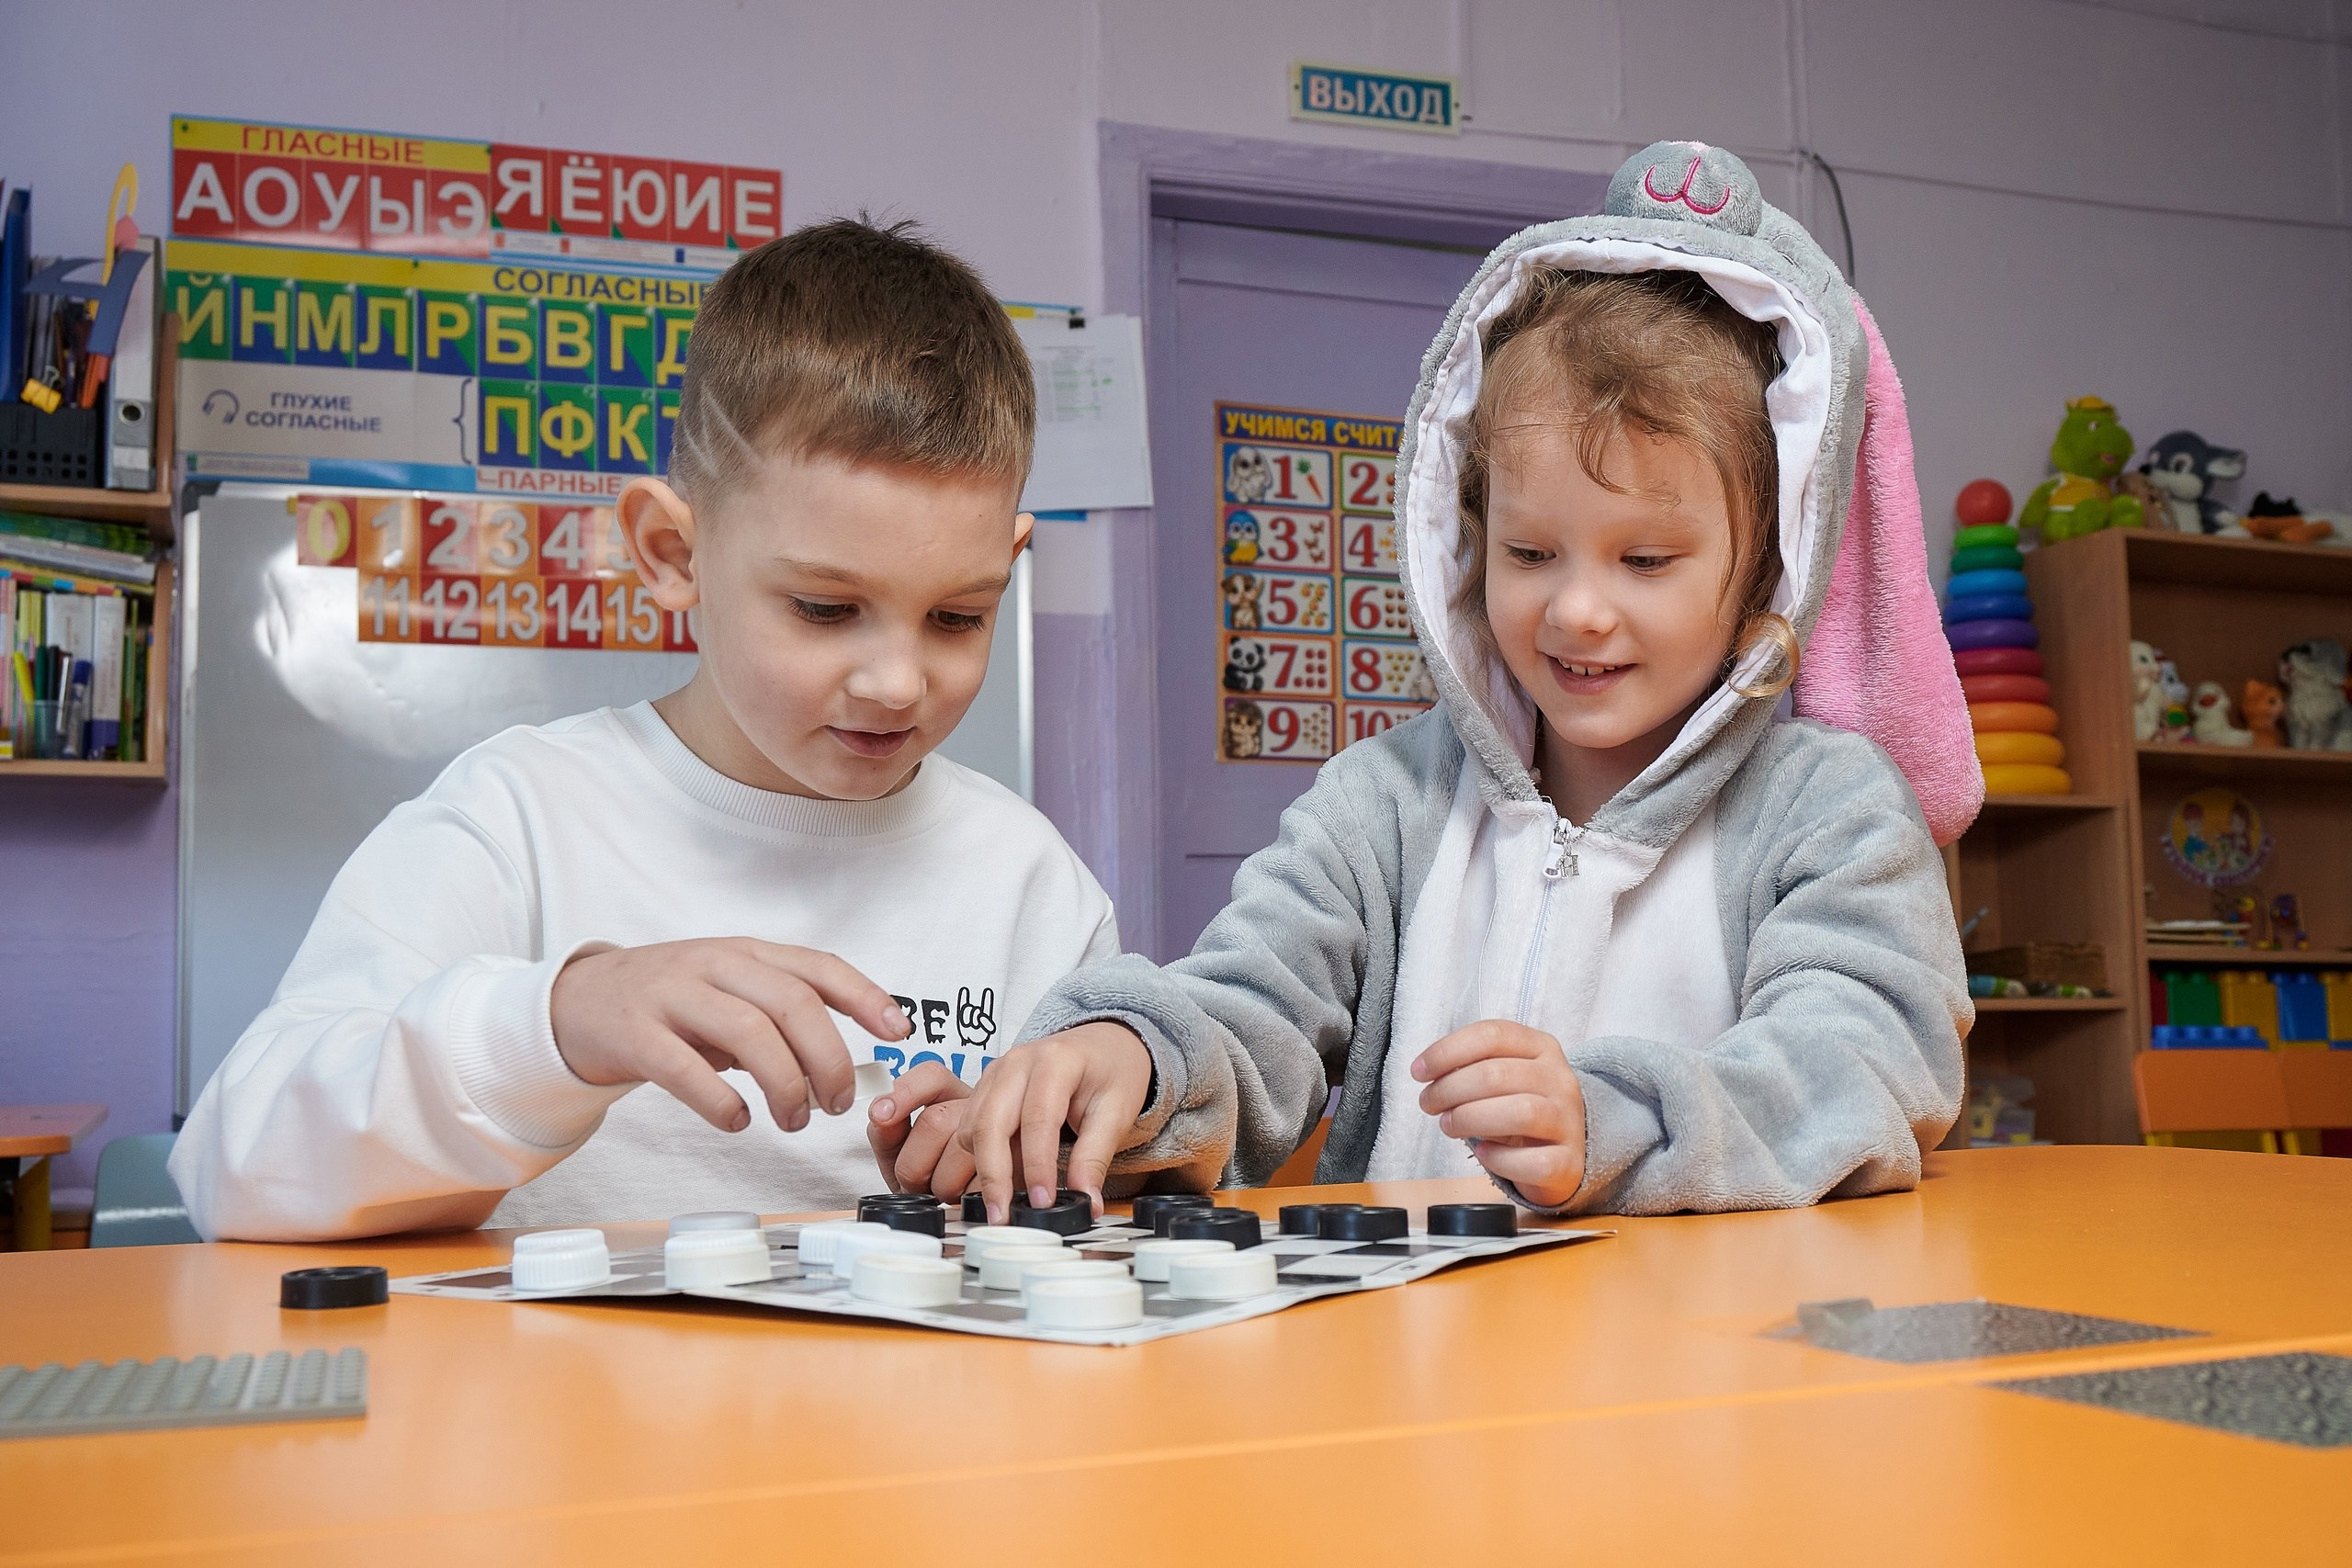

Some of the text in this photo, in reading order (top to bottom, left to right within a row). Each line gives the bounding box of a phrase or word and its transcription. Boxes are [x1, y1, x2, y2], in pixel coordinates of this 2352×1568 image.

[1308, 75, 1445, 124] ВЫХОД
[242, 126, 424, 164] ГЛАСНЫЕ
[245, 411, 382, 433] СОГЛАСНЫЕ
[270, 391, 352, 412] ГЛУХИЕ
[1226, 412, 1326, 441] УЧИМСЯ
[499, 469, 622, 495] ПАРНЫЕ
[1272, 456, 1378, 505] 1 2
[427, 506, 469, 567] 2
[488, 509, 530, 568] 3
[542, 511, 584, 570] 4
[1269, 517, 1378, 567] 3 4
[364, 577, 697, 644] 11 12 13 14 15 1
[1268, 580, 1381, 630] 5 6
[1269, 645, 1381, 692] 7 8
[1268, 706, 1299, 751] 9
